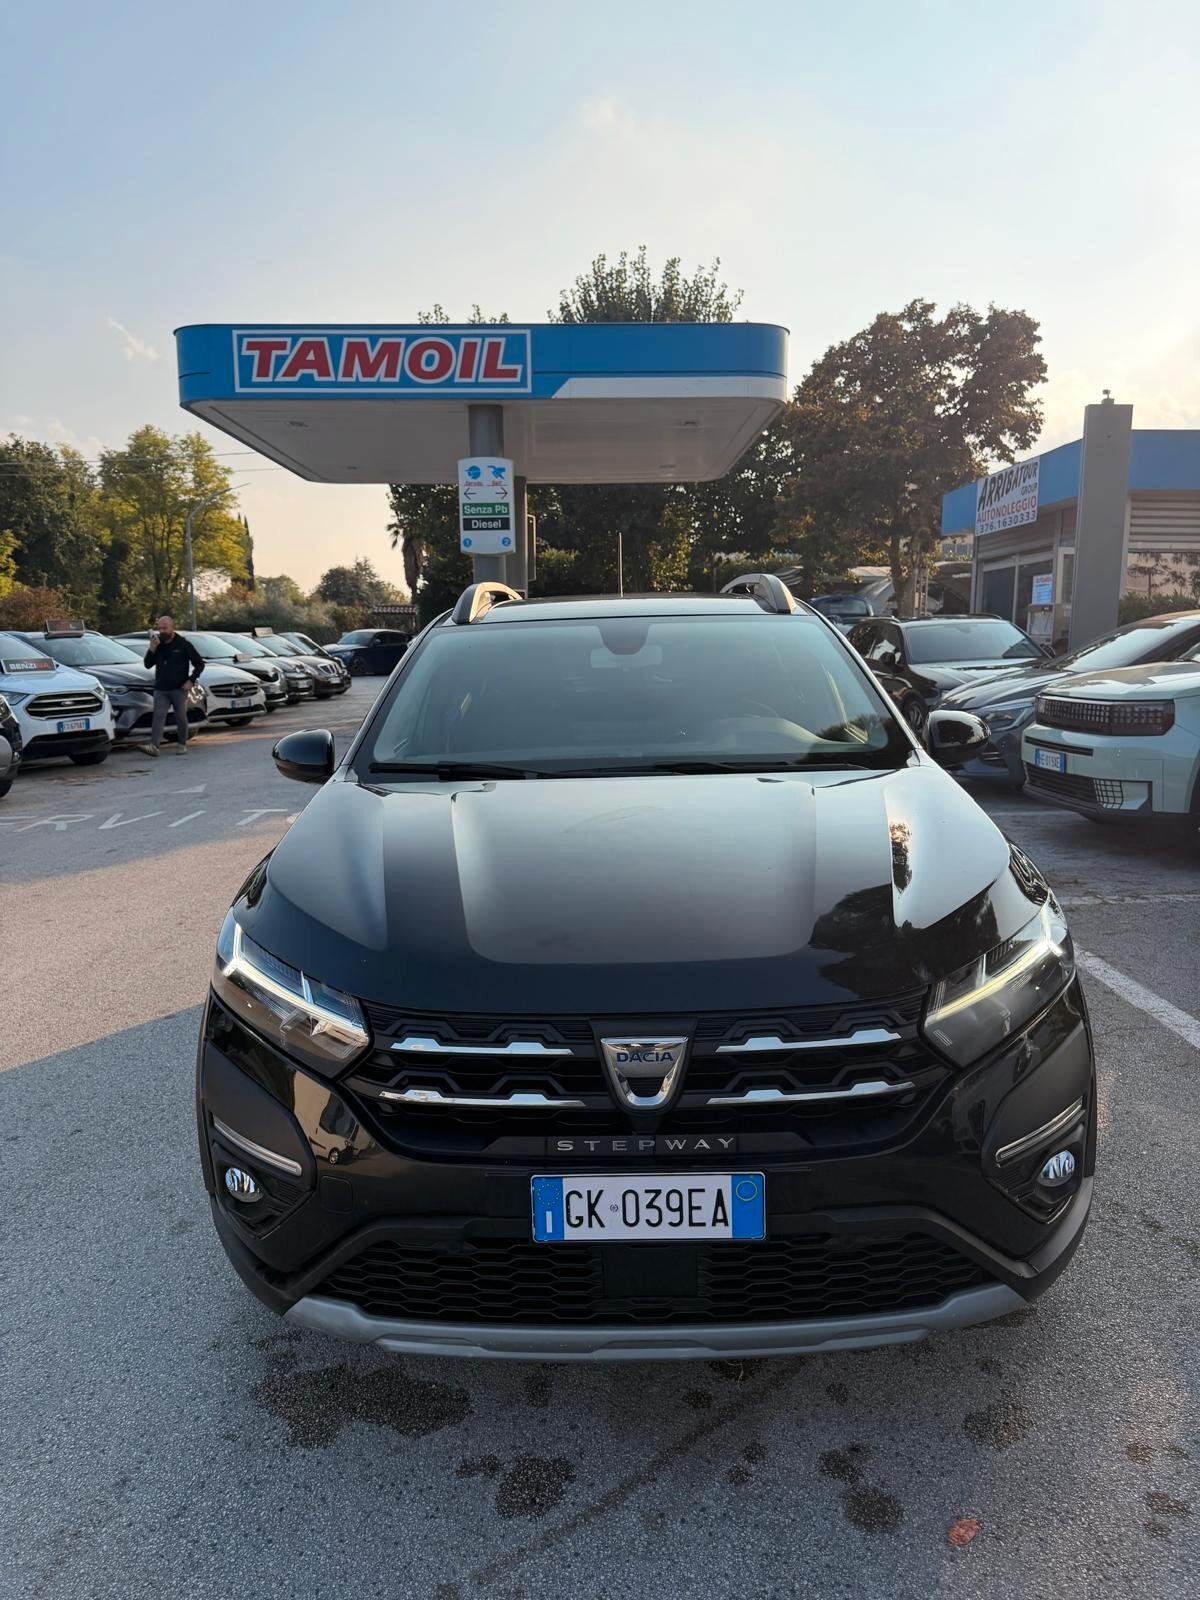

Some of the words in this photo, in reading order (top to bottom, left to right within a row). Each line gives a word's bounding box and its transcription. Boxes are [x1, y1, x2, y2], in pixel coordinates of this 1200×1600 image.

[241, 336, 523, 384] TAMOIL
[464, 505, 493, 514] Senza
[495, 504, 508, 513] Pb
[977, 496, 1037, 524] AUTONOLEGGIO
[471, 520, 502, 529] Diesel
[980, 510, 1036, 534] 376.1630333
[616, 1051, 674, 1063] DACIA
[557, 1137, 734, 1151] STEPWAY
[565, 1189, 605, 1228] GK
[621, 1187, 730, 1228] 039EA
